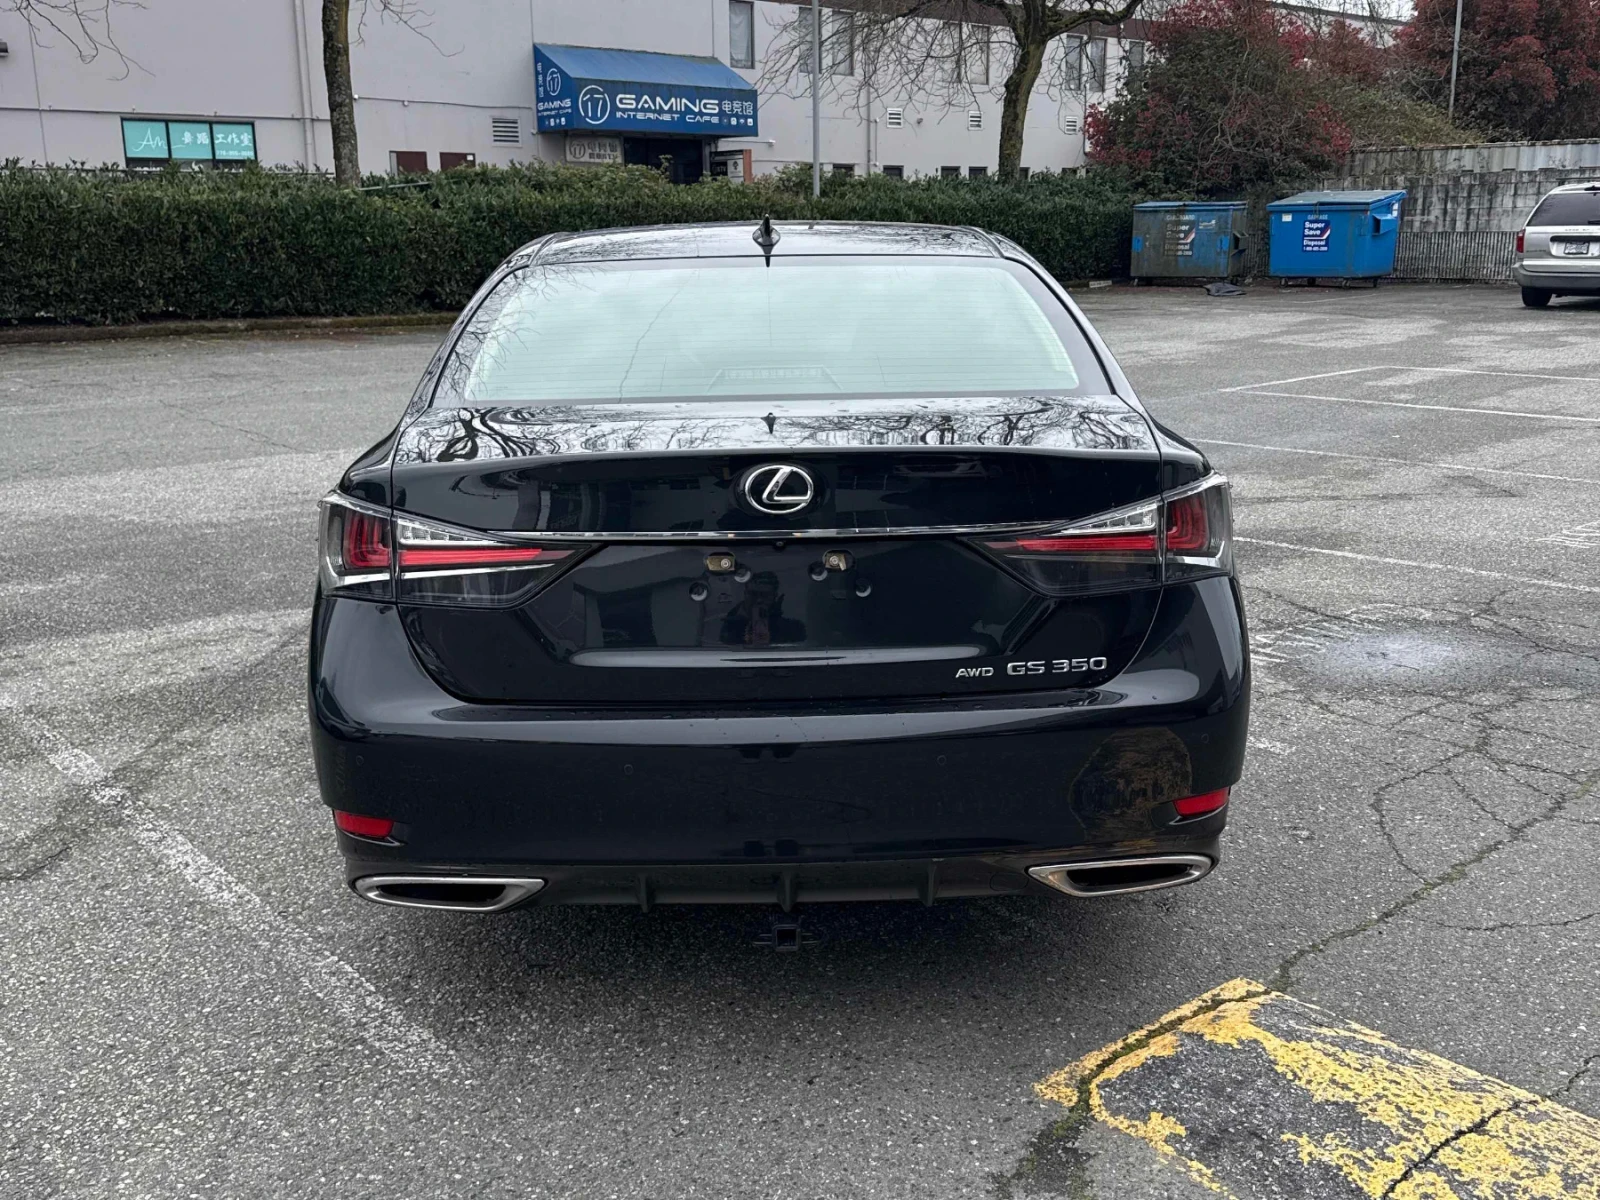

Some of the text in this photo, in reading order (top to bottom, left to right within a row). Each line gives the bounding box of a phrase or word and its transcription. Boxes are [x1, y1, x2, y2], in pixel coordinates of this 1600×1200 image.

[537, 98, 572, 111] GAMING
[616, 94, 719, 114] GAMING
[721, 99, 754, 116] 电竞馆
[616, 111, 720, 124] INTERNET CAFE
[1304, 221, 1325, 229] Super
[1304, 228, 1321, 236] Save
[955, 656, 1108, 678] AWD GS 350
